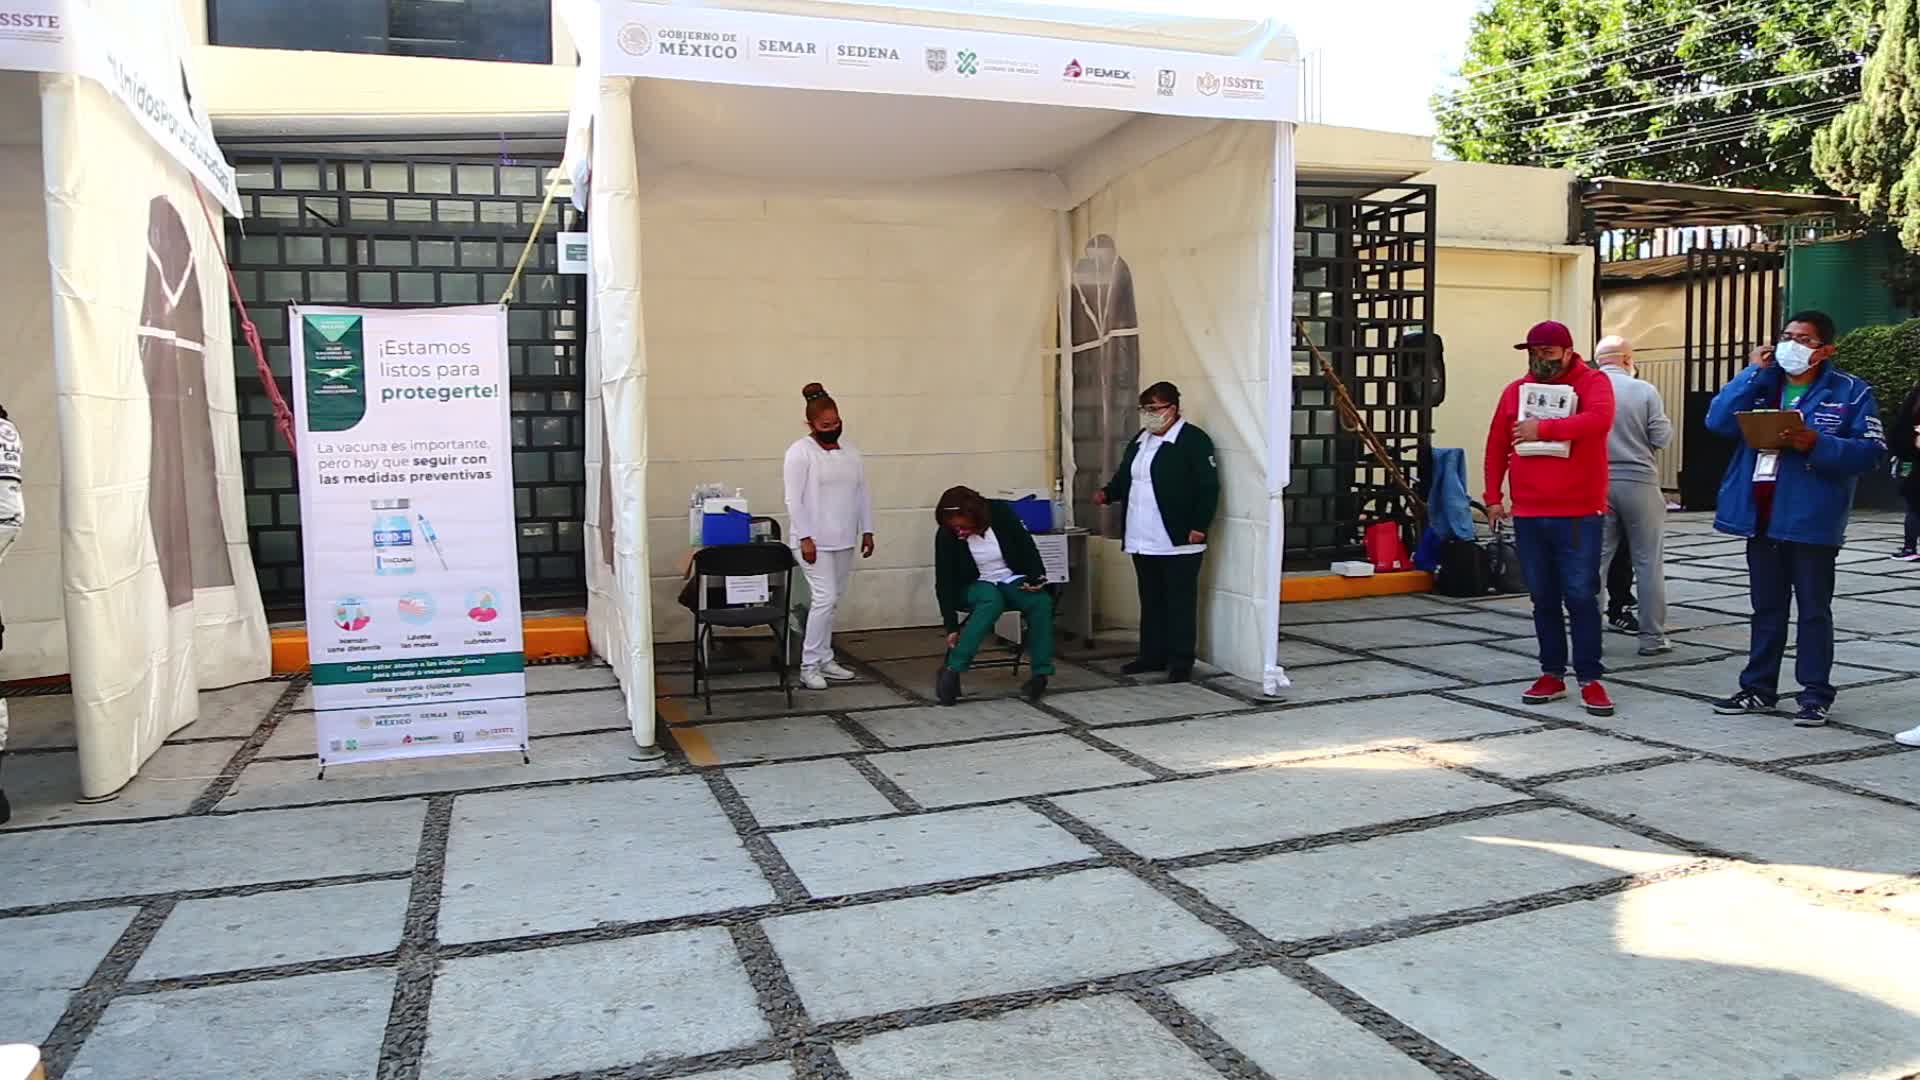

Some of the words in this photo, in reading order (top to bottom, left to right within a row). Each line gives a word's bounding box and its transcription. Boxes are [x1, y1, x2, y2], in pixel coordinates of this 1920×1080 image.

[658, 30, 720, 42] GOBIERNO
[722, 33, 737, 42] DE
[659, 40, 737, 59] MÉXICO
[758, 40, 816, 54] SEMAR
[837, 45, 900, 60] SEDENA
[1085, 66, 1130, 80] PEMEX
[1223, 76, 1264, 90] ISSSTE
[379, 339, 471, 358] ¡Estamos
[380, 362, 431, 377] listos
[437, 364, 480, 380] para
[382, 384, 498, 403] protegerte!
[317, 444, 334, 453] La
[338, 443, 388, 452] vacuna
[391, 442, 406, 451] es
[319, 459, 350, 471] pero
[355, 457, 378, 470] hay
[382, 458, 409, 468] que
[413, 455, 457, 467] seguir
[462, 455, 487, 465] con
[319, 474, 339, 484] las
[344, 471, 406, 484] medidas
[410, 469, 493, 483] preventivas
